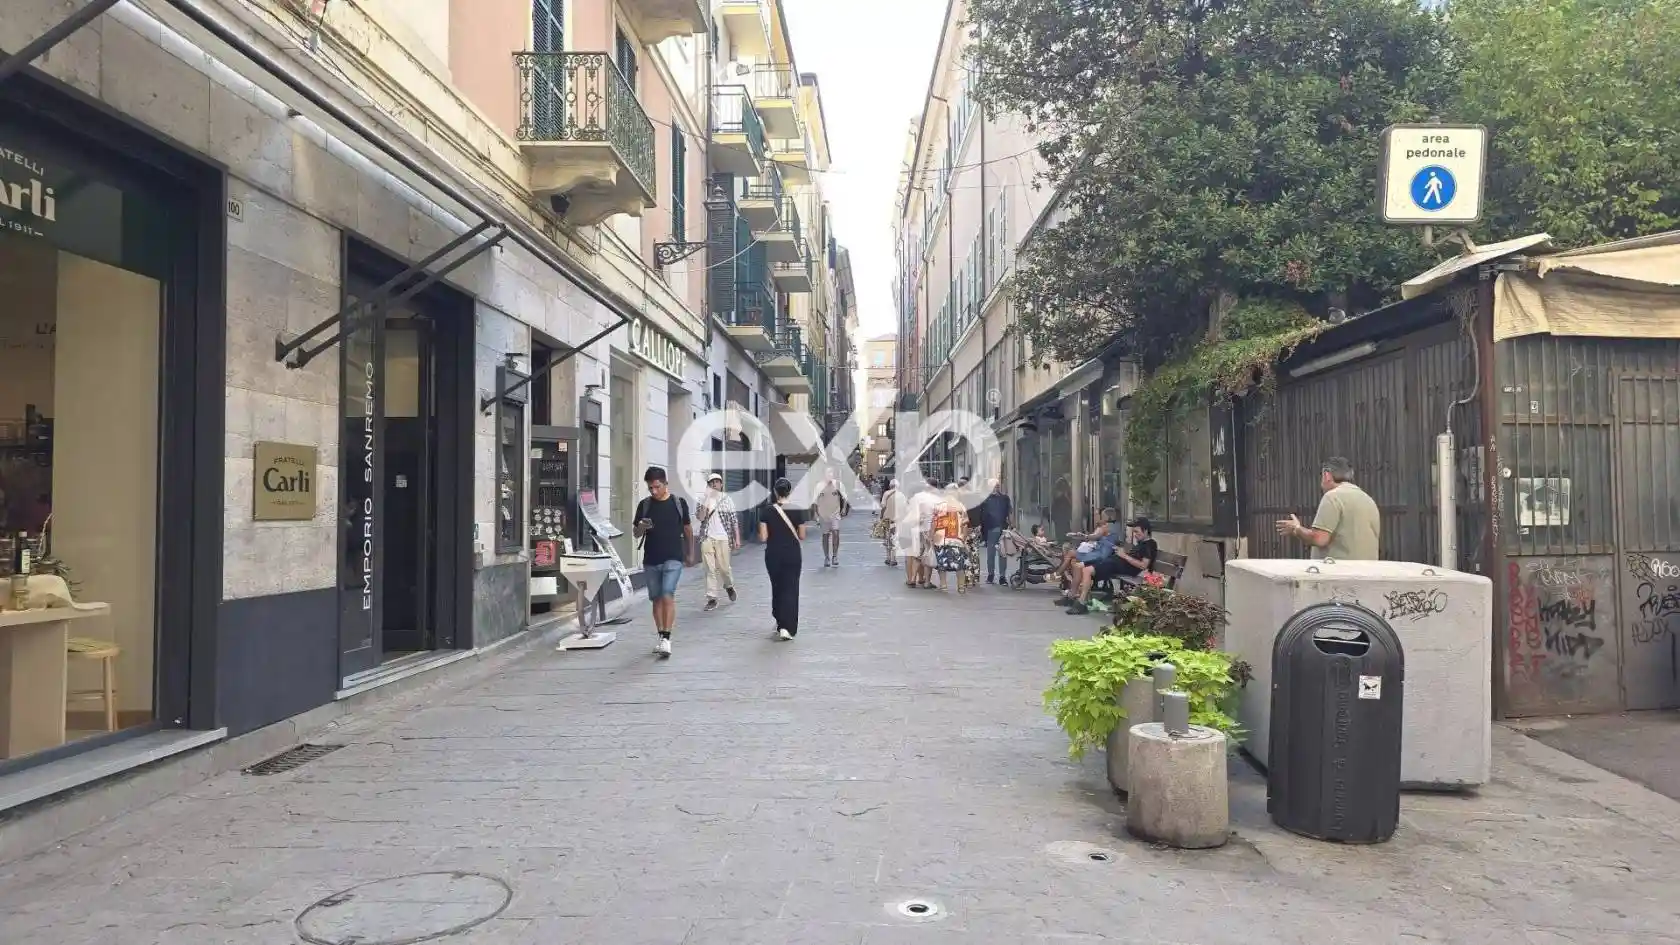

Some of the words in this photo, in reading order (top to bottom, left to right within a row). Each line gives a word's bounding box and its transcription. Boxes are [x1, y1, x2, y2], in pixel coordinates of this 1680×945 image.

[1422, 135, 1450, 144] area
[1406, 148, 1466, 160] pedonale
[228, 201, 240, 216] 100
[364, 362, 374, 483] SANREMO
[263, 467, 310, 493] Carli
[363, 497, 373, 610] EMPORIO
